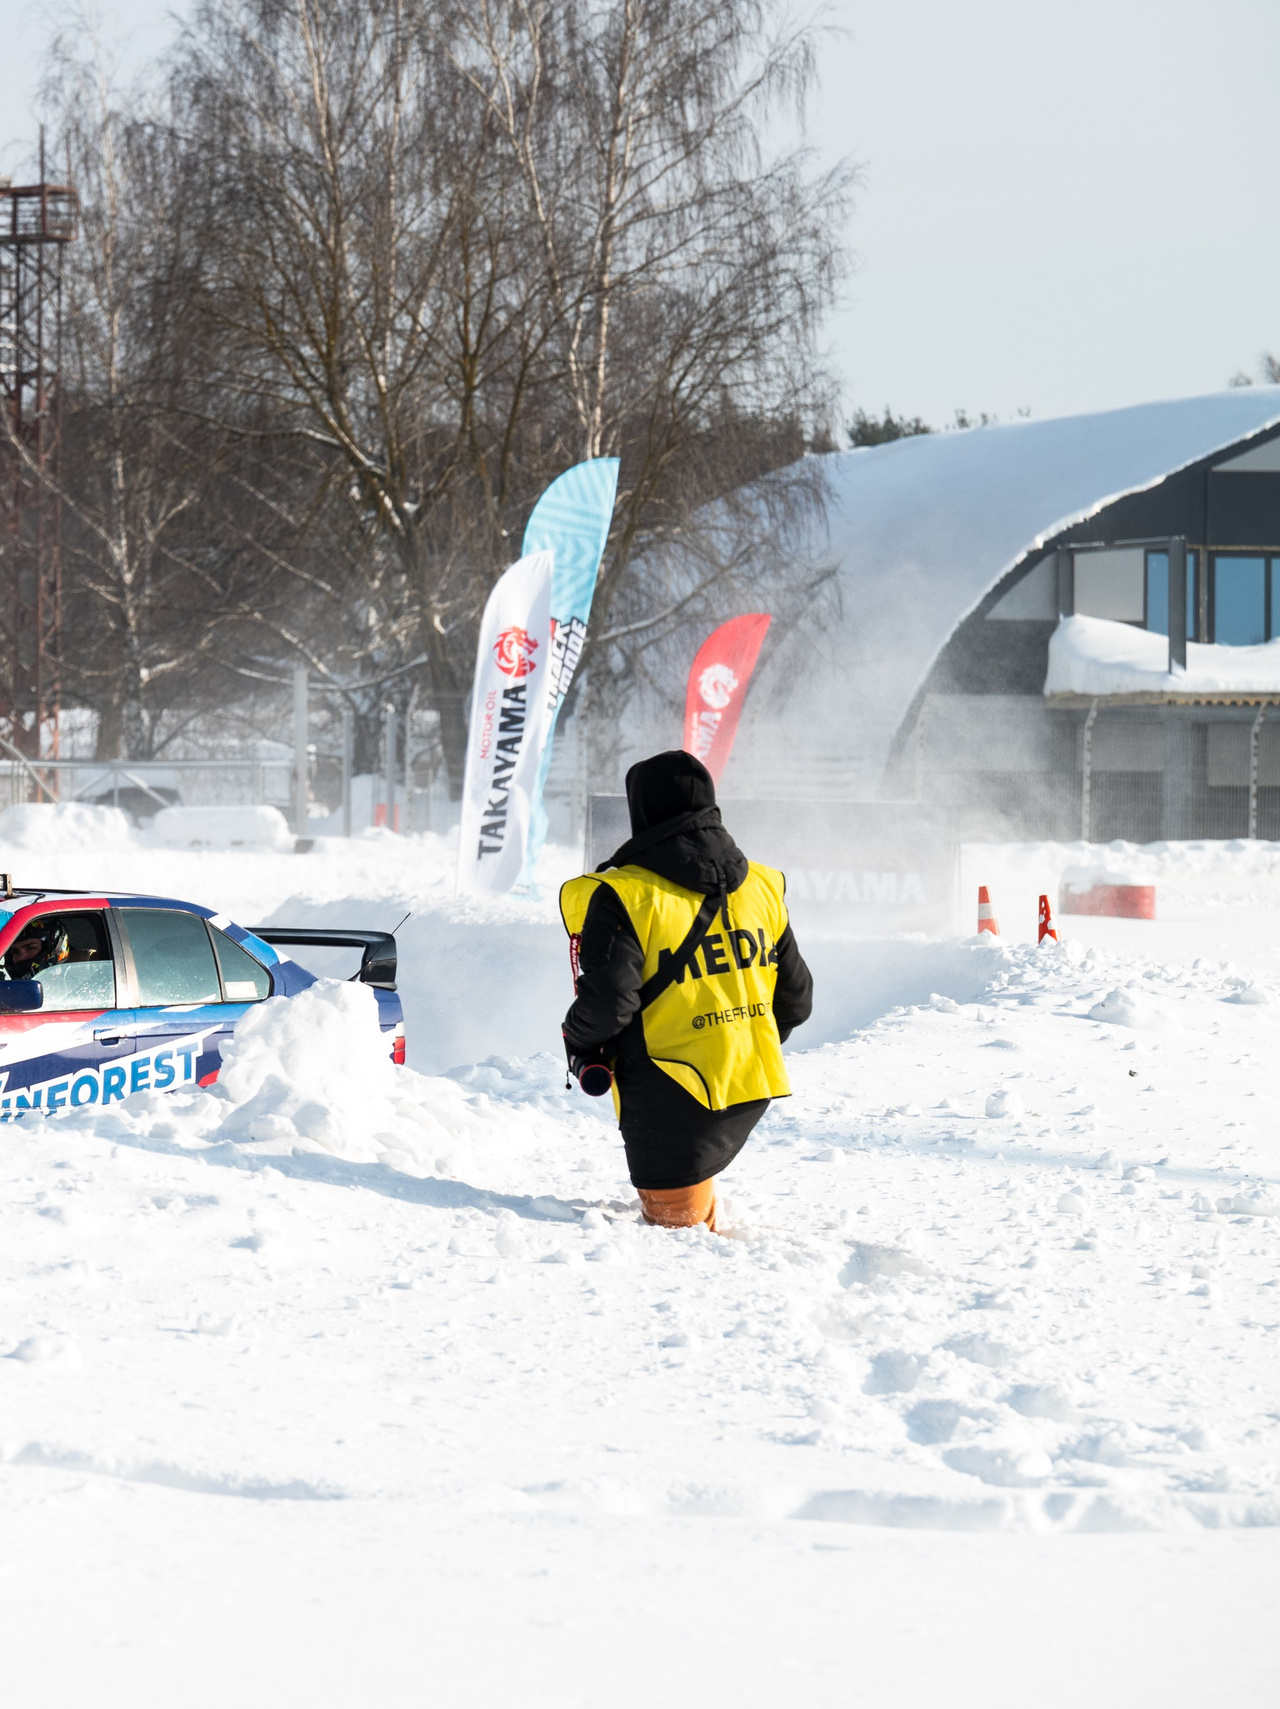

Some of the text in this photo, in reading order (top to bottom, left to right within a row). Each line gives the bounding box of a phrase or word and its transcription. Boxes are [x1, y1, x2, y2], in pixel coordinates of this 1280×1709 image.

[480, 690, 498, 760] MOTOR OIL
[477, 683, 527, 860] TAKAYAMA
[786, 868, 928, 905] AYAMA
[691, 1002, 771, 1030] @THEFRUD
